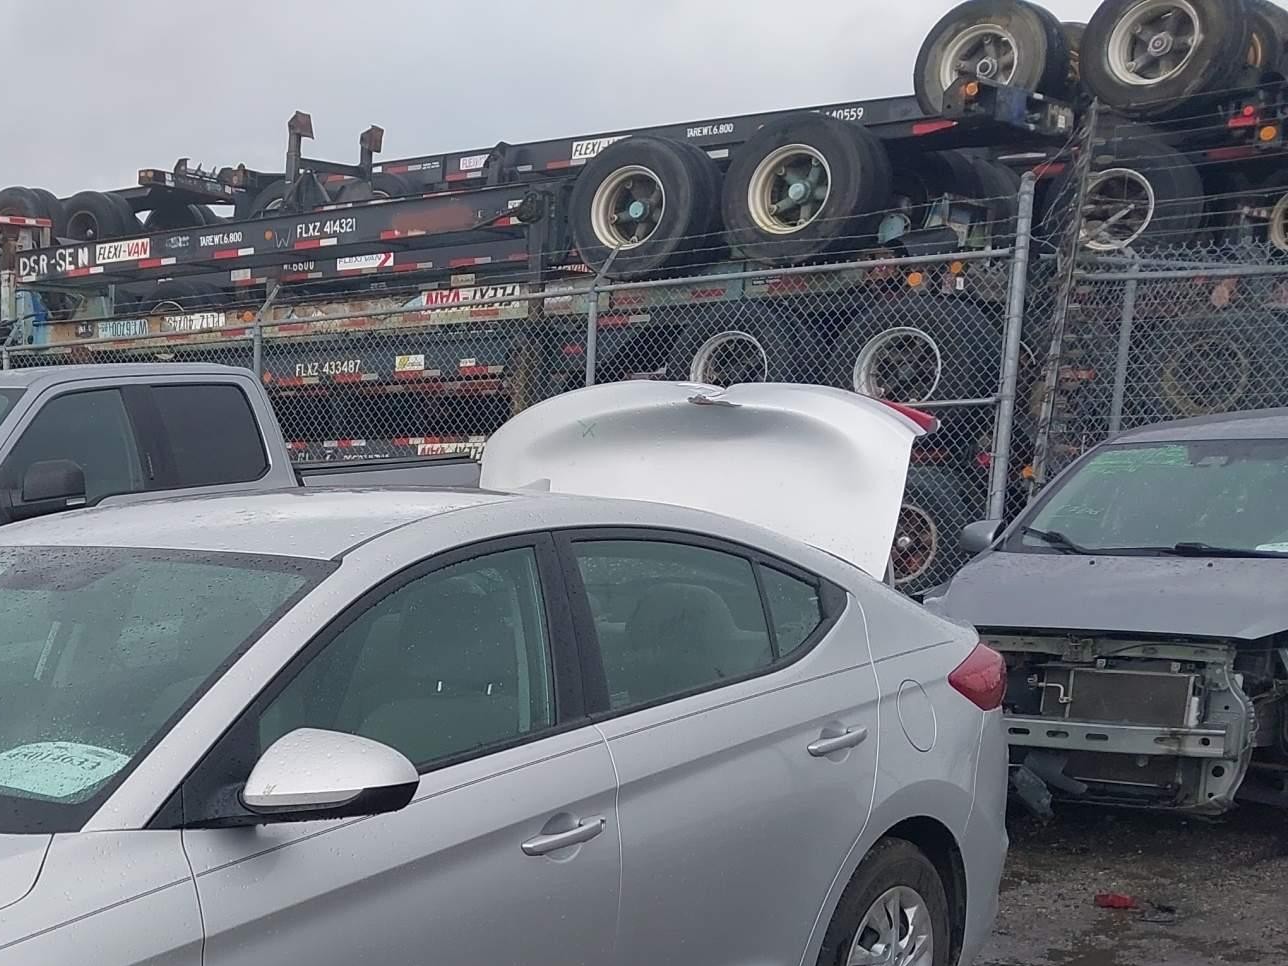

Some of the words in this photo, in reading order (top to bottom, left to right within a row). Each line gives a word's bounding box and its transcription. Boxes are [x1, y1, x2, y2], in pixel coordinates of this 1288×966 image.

[296, 222, 321, 239] FLXZ
[323, 218, 356, 236] 414321
[97, 240, 149, 261] FLEXI-VAN
[295, 362, 319, 377] FLXZ
[322, 359, 361, 375] 433487
